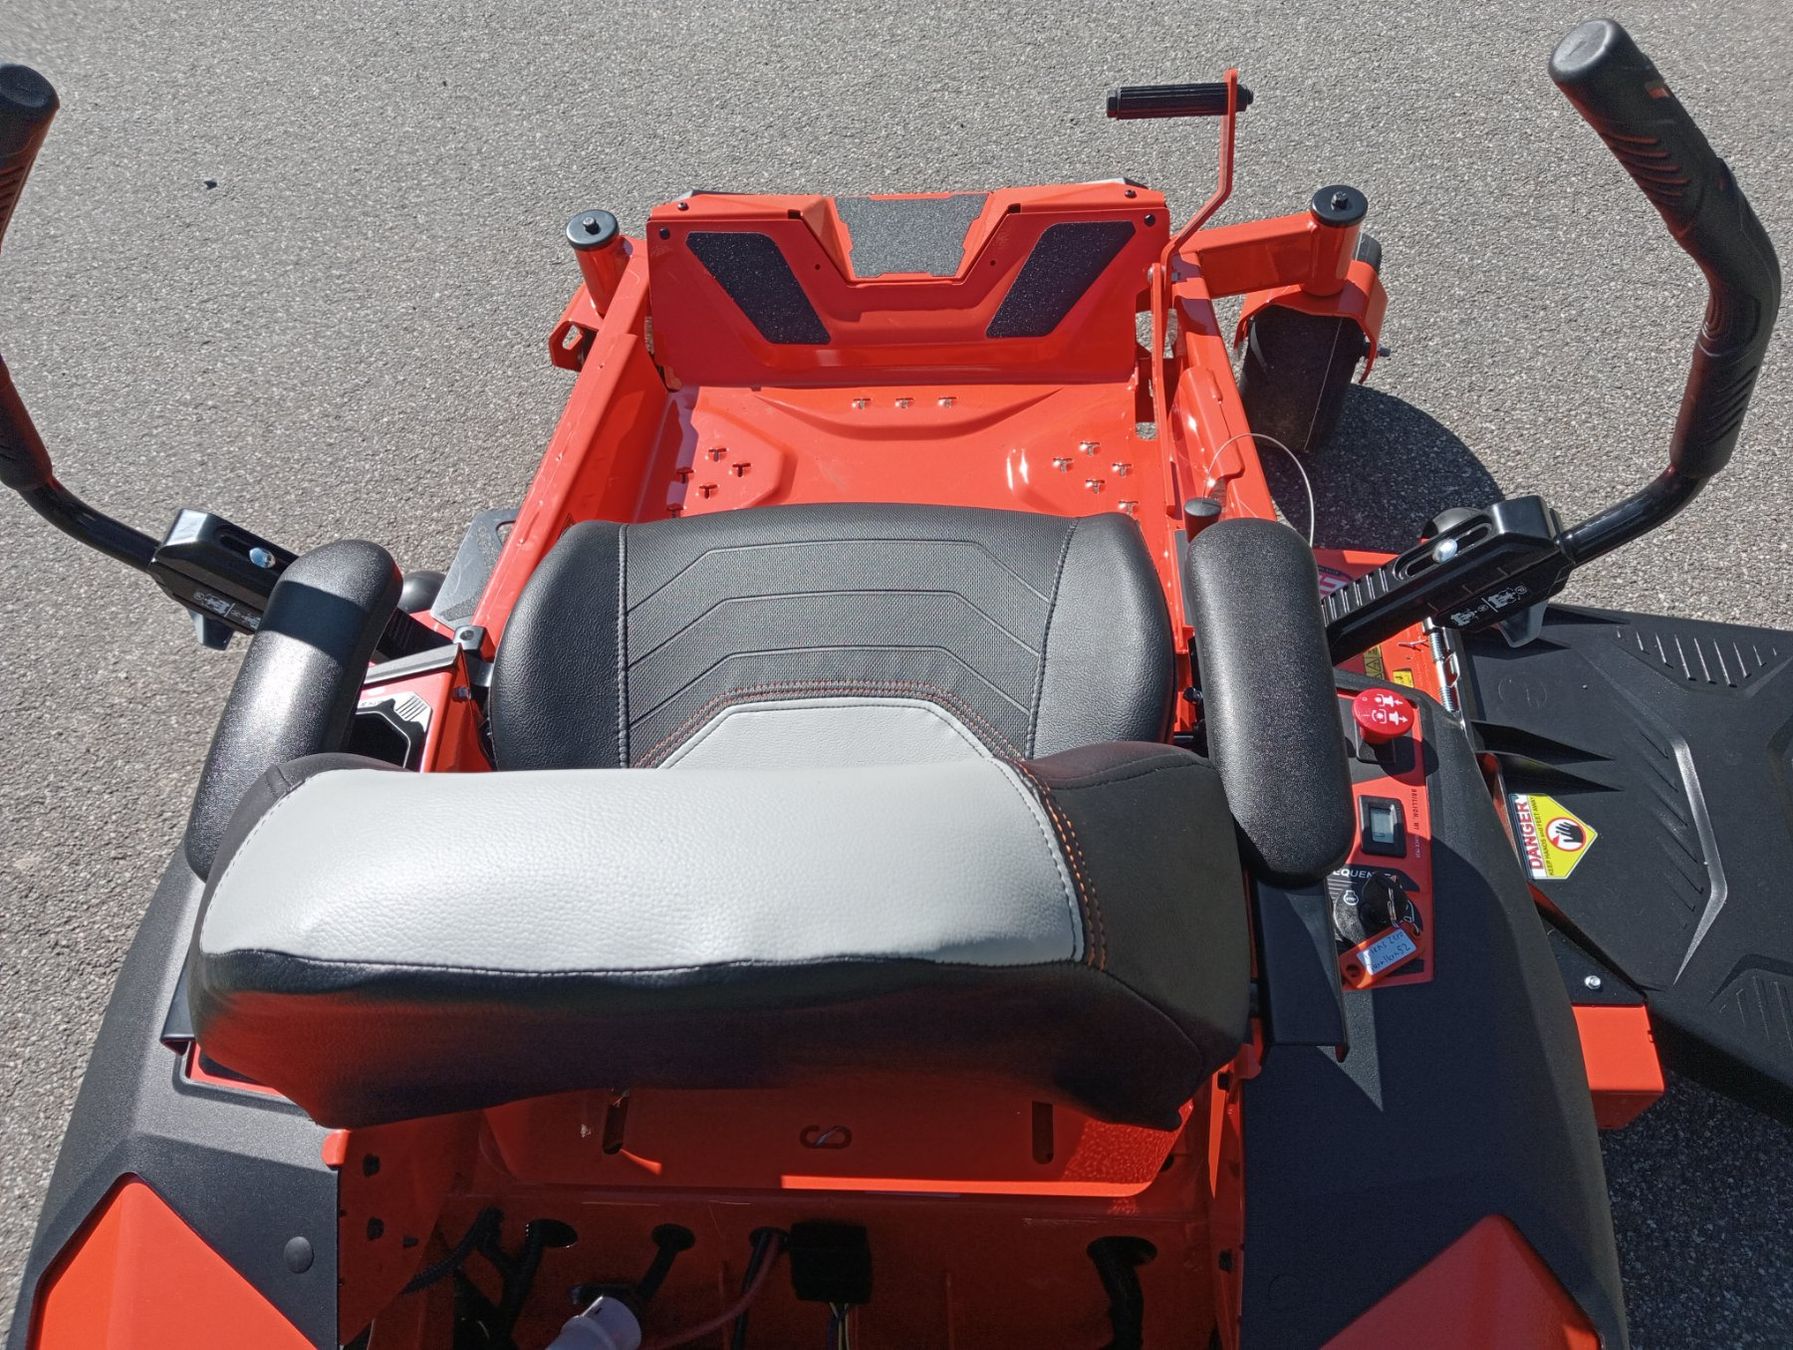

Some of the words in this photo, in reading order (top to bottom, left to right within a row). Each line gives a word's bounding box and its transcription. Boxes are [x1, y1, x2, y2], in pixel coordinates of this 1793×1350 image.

[1530, 796, 1539, 812] AWAY
[1533, 812, 1543, 827] FEET
[1515, 802, 1543, 869] DANGER
[1540, 838, 1551, 859] HANDS
[1545, 859, 1554, 876] KEEP
